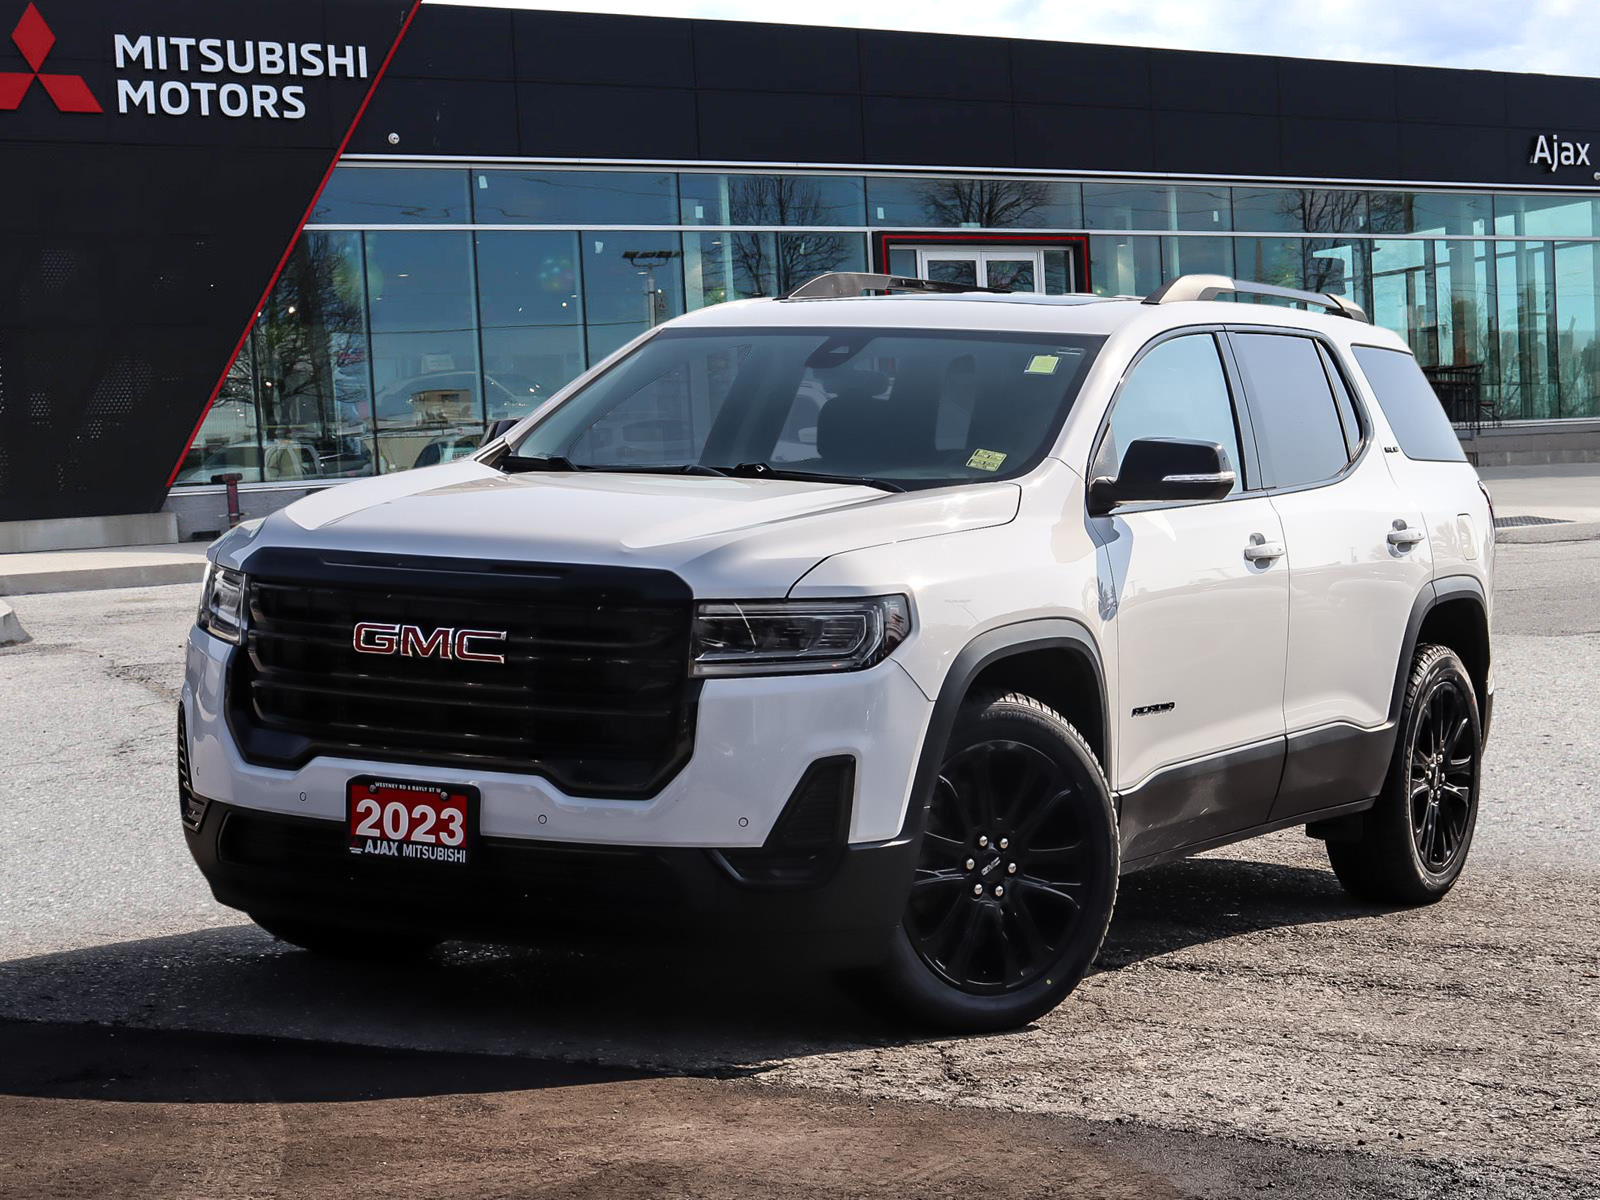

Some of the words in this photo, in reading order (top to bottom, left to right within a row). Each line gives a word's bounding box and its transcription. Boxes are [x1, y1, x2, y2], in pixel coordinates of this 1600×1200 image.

[114, 33, 368, 79] MITSUBISHI
[117, 79, 307, 119] MOTORS
[1533, 134, 1591, 173] Ajax
[353, 621, 507, 664] GMC
[355, 799, 464, 846] 2023
[364, 839, 399, 857] AJAX
[402, 843, 466, 863] MITSUBISHI
